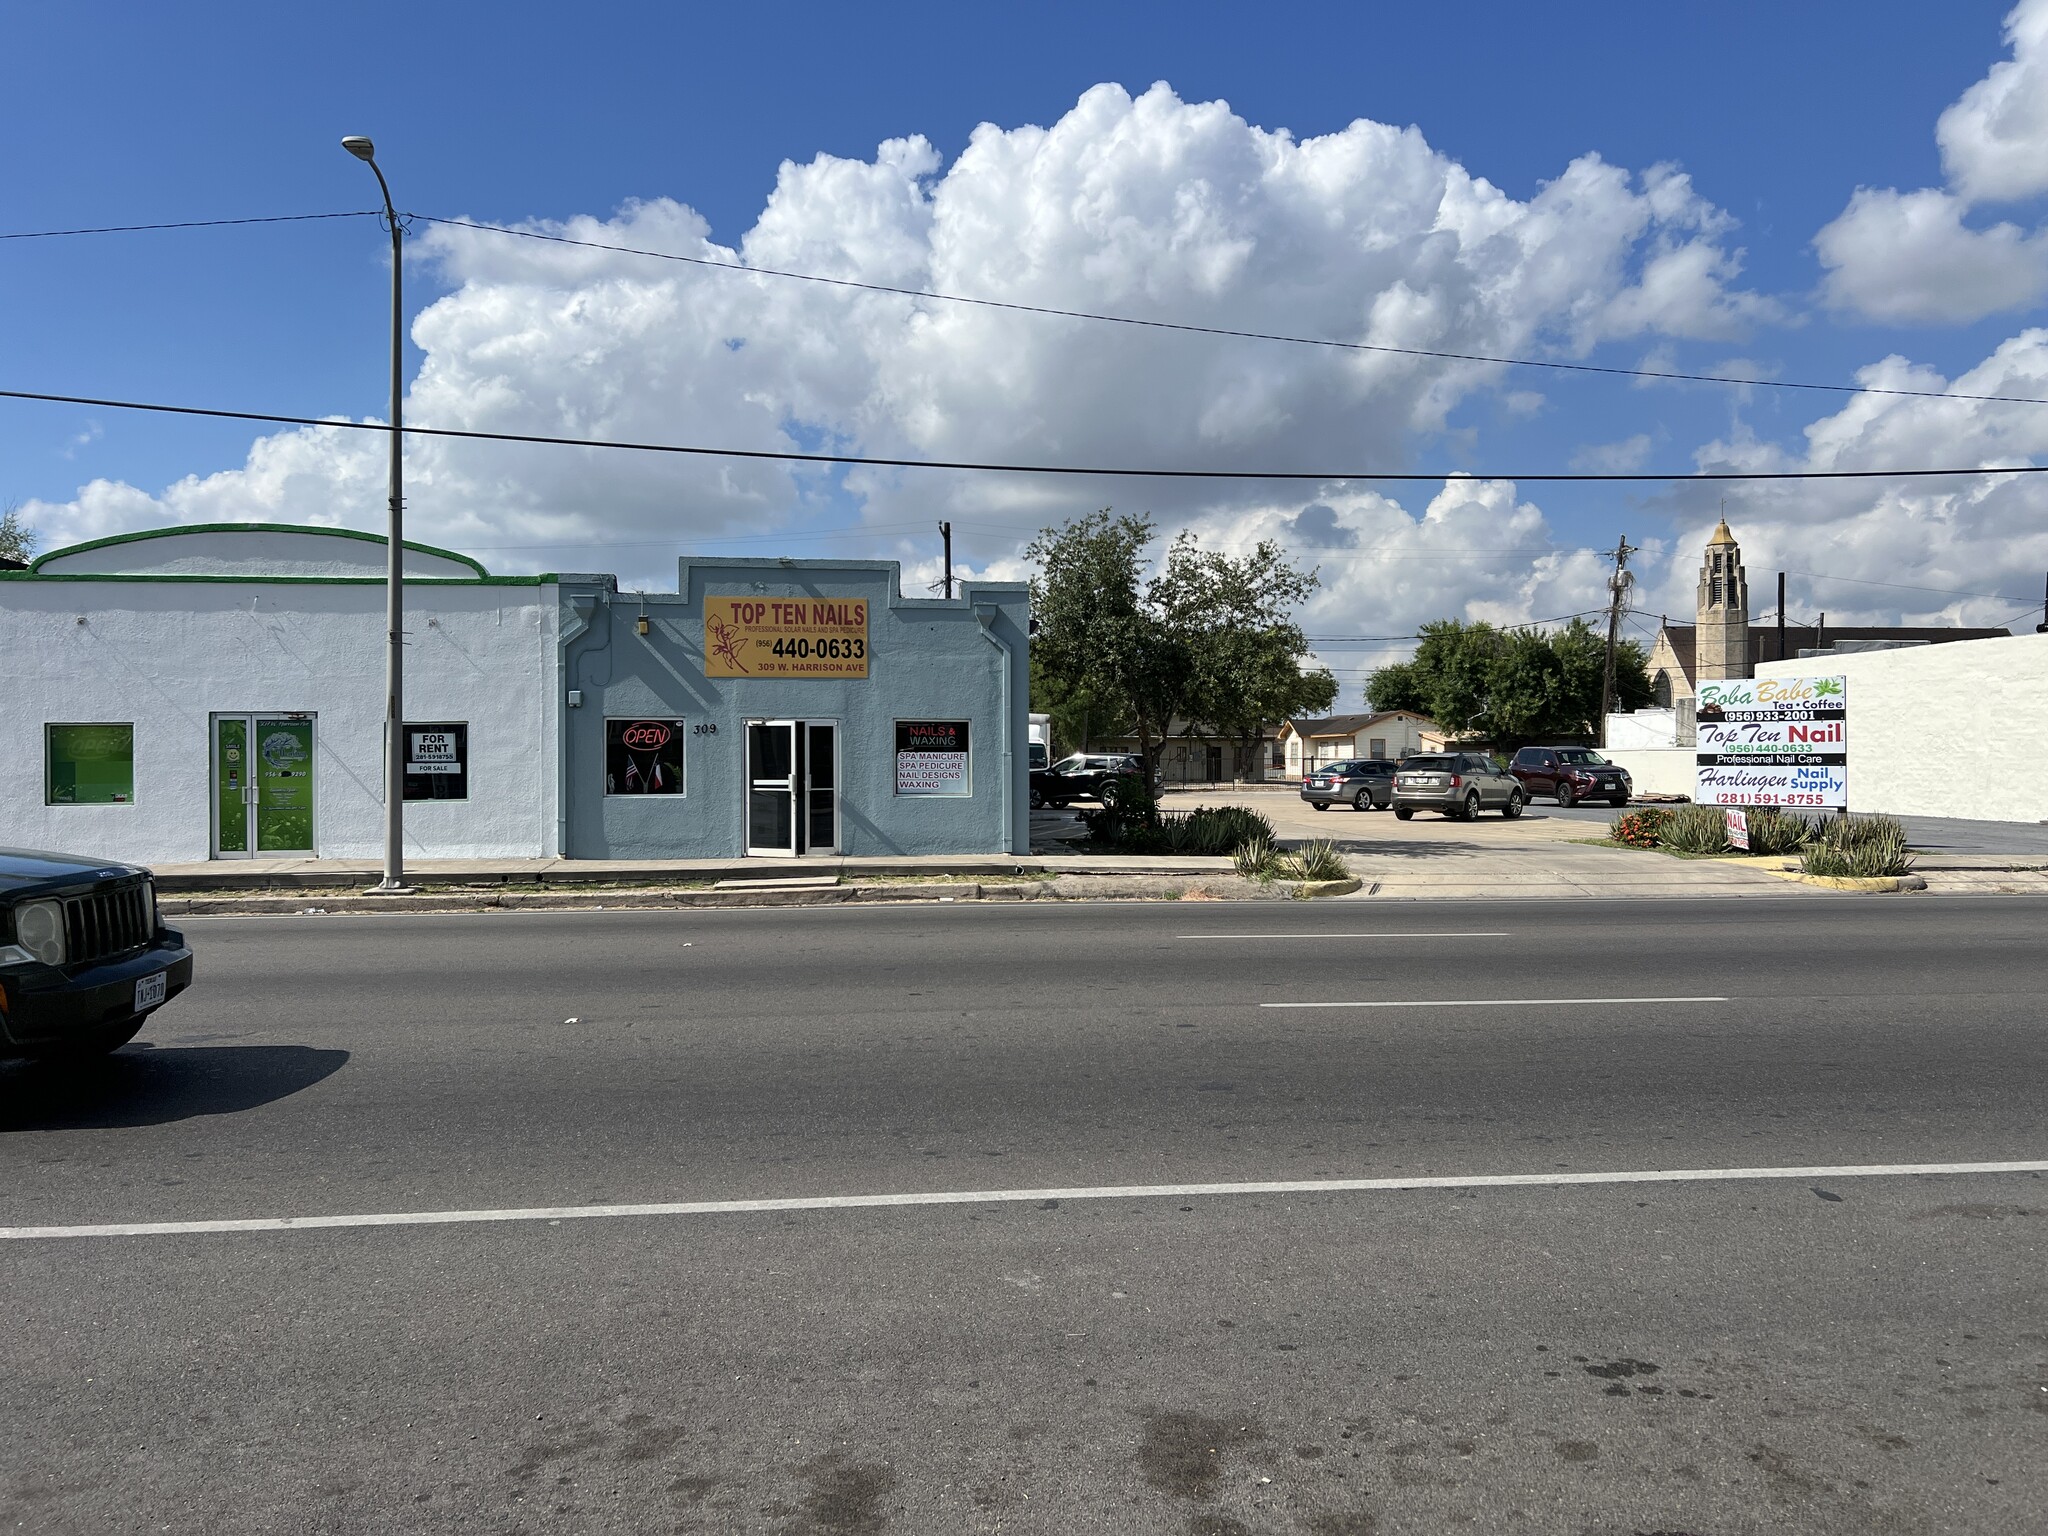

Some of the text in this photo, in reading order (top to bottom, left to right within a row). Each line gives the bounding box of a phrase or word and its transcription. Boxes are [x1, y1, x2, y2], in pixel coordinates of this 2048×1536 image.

[731, 603, 864, 626] TOP TEN NAILS
[756, 638, 864, 659] (956) 440-0633
[758, 663, 775, 671] 309
[778, 663, 789, 671] W.
[792, 663, 843, 671] HARRISON
[1700, 679, 1812, 706] Boba Babe
[1772, 699, 1843, 710] Tea Coffee
[693, 724, 717, 734] 309
[909, 726, 945, 736] NAILS
[422, 735, 445, 743] FOR
[625, 729, 667, 743] OPEN
[1699, 723, 1841, 747] Top Ten Nail
[909, 736, 956, 745] WAXING
[419, 744, 449, 753] RENT
[1717, 755, 1822, 764] Professional Nail Care
[919, 762, 963, 770] PEDICURE
[1797, 768, 1829, 778] Nail
[1699, 768, 1787, 792] Harlingen
[1791, 777, 1843, 792] Supply
[1728, 813, 1746, 832] NAIL
